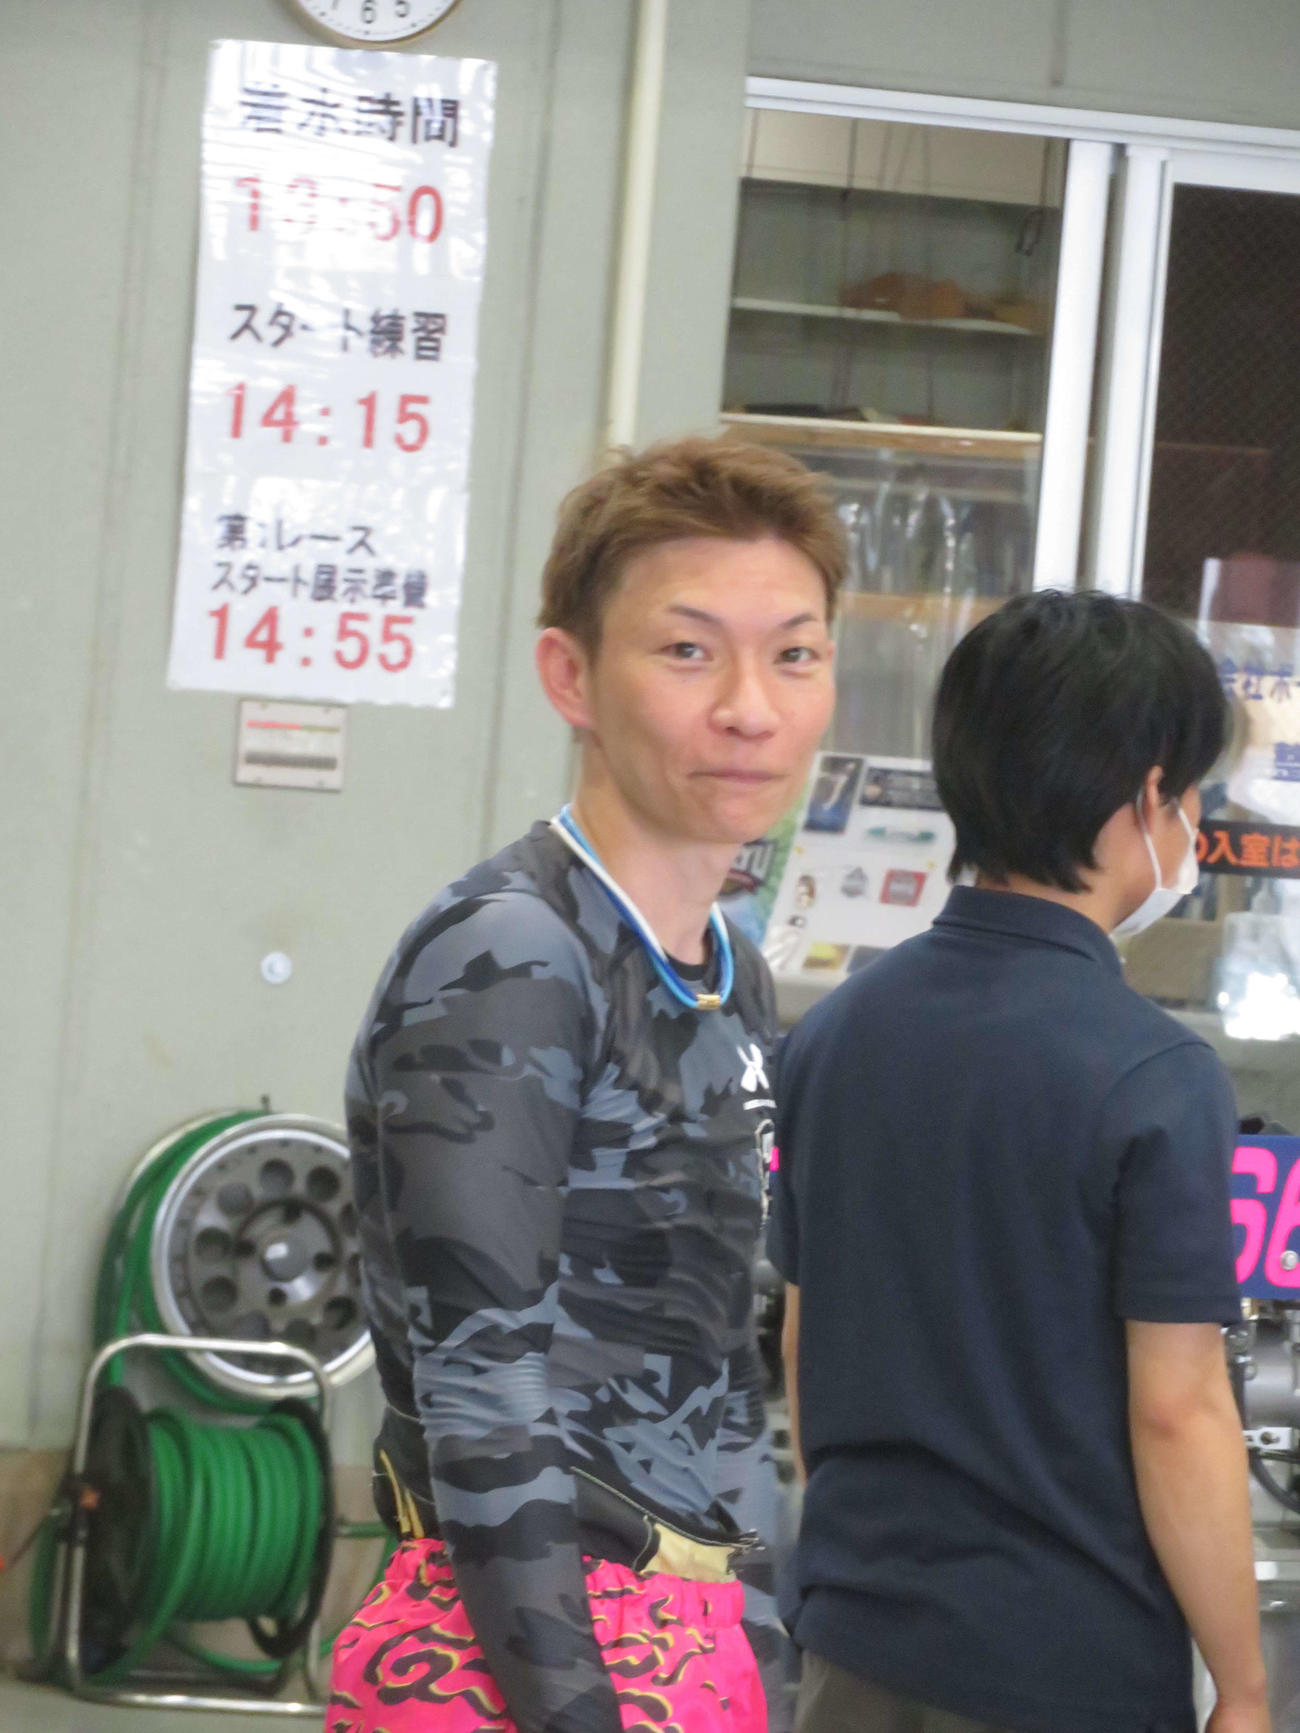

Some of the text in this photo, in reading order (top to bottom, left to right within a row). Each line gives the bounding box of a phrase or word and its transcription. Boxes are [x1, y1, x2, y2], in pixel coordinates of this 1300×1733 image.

[229, 303, 447, 362] スタート練習
[225, 382, 430, 453] 14:15
[209, 602, 415, 673] 14:55
